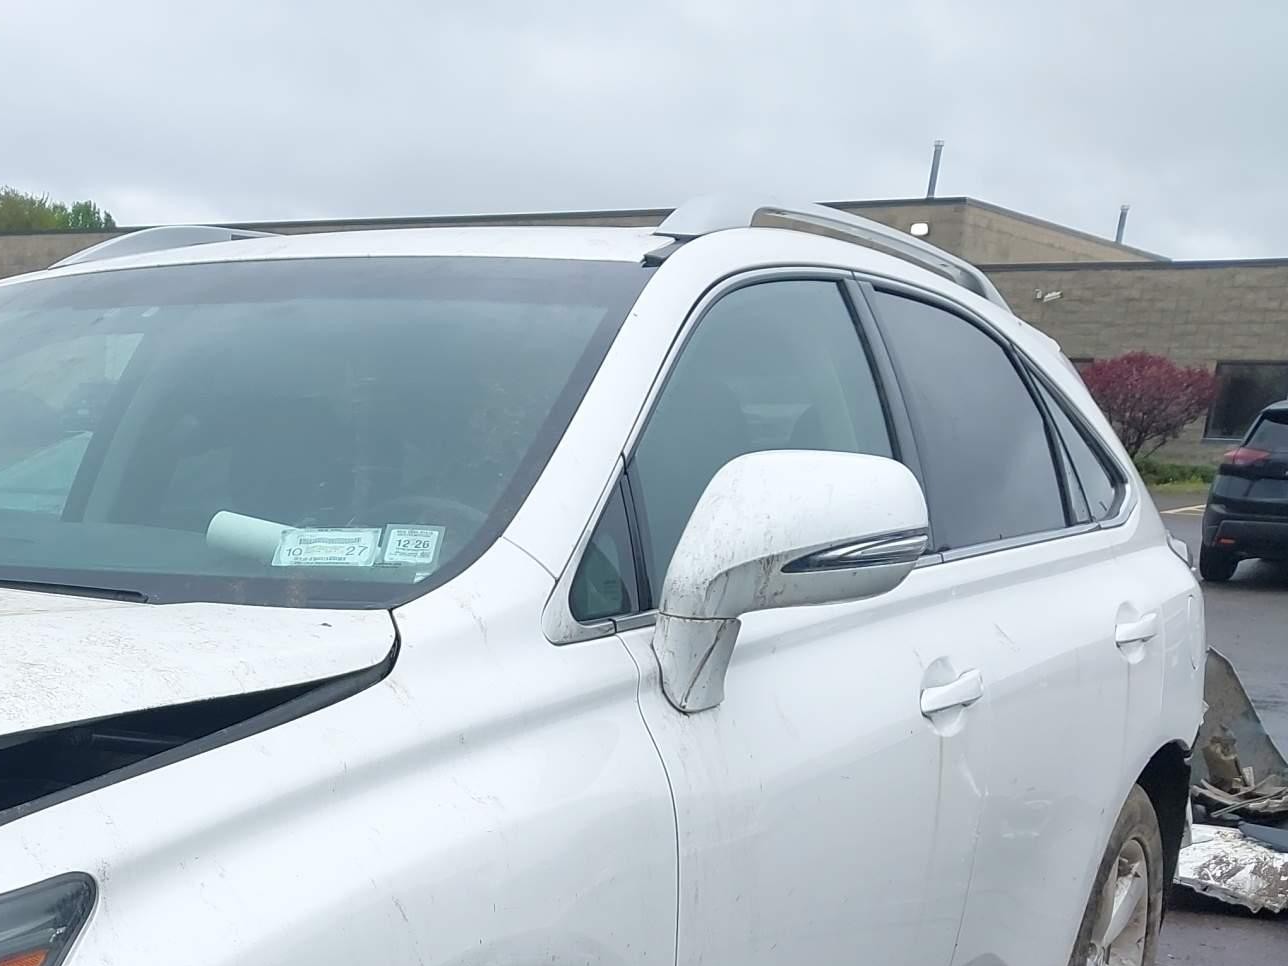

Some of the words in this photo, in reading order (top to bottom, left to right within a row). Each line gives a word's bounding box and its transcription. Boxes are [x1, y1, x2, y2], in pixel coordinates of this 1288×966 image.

[396, 539, 410, 548] 12
[414, 540, 430, 549] 26
[286, 547, 303, 557] 10
[345, 545, 368, 556] 27
